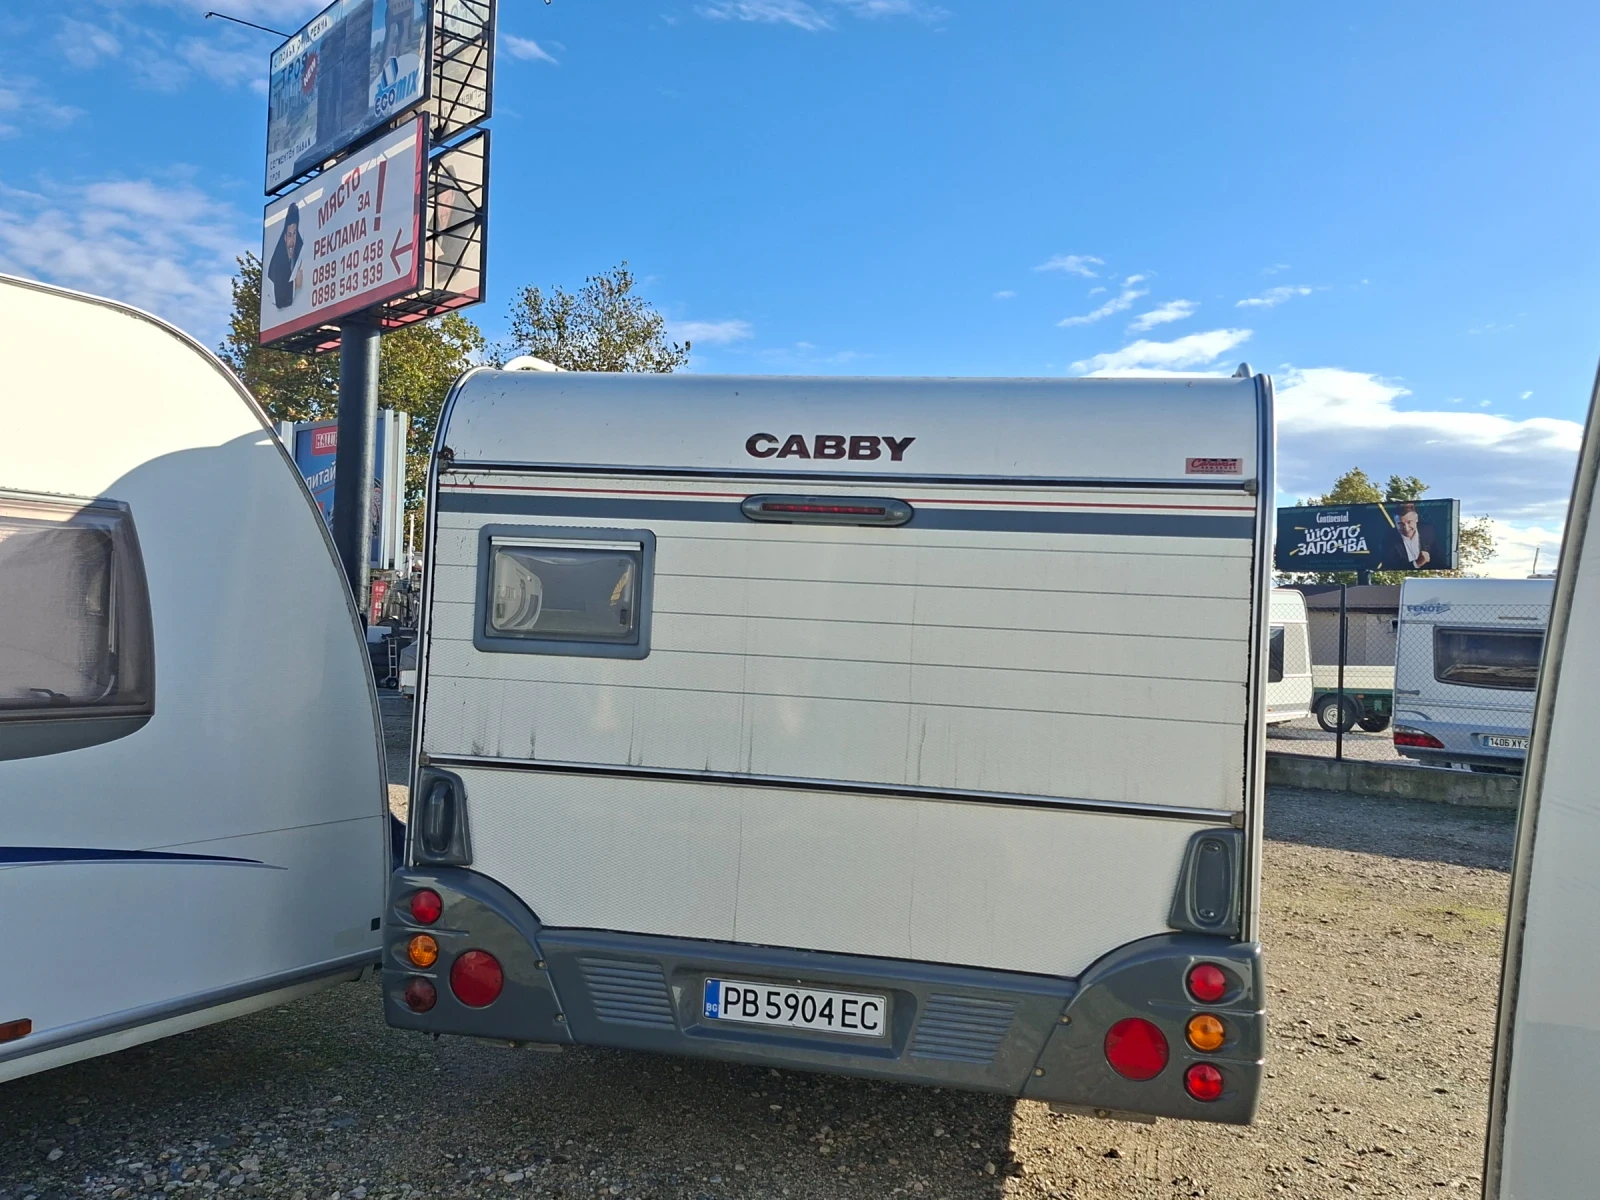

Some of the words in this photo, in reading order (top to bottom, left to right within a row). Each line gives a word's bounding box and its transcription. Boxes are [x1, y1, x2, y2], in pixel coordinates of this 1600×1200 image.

[303, 57, 316, 87] NEW
[318, 166, 360, 230] МЯСТО
[357, 190, 371, 212] ЗА
[313, 217, 367, 261] РЕКЛАМА
[312, 259, 337, 287] 0899
[340, 249, 360, 274] 140
[363, 238, 384, 264] 458
[311, 281, 336, 307] 0898
[339, 271, 359, 297] 543
[362, 261, 383, 288] 939
[745, 432, 917, 462] CABBY
[1316, 511, 1350, 523] Continental
[1297, 537, 1368, 556] ЗАПОЧВА
[1304, 525, 1361, 542] ШОУТО
[1490, 737, 1510, 747] 1406
[706, 1003, 718, 1012] BG
